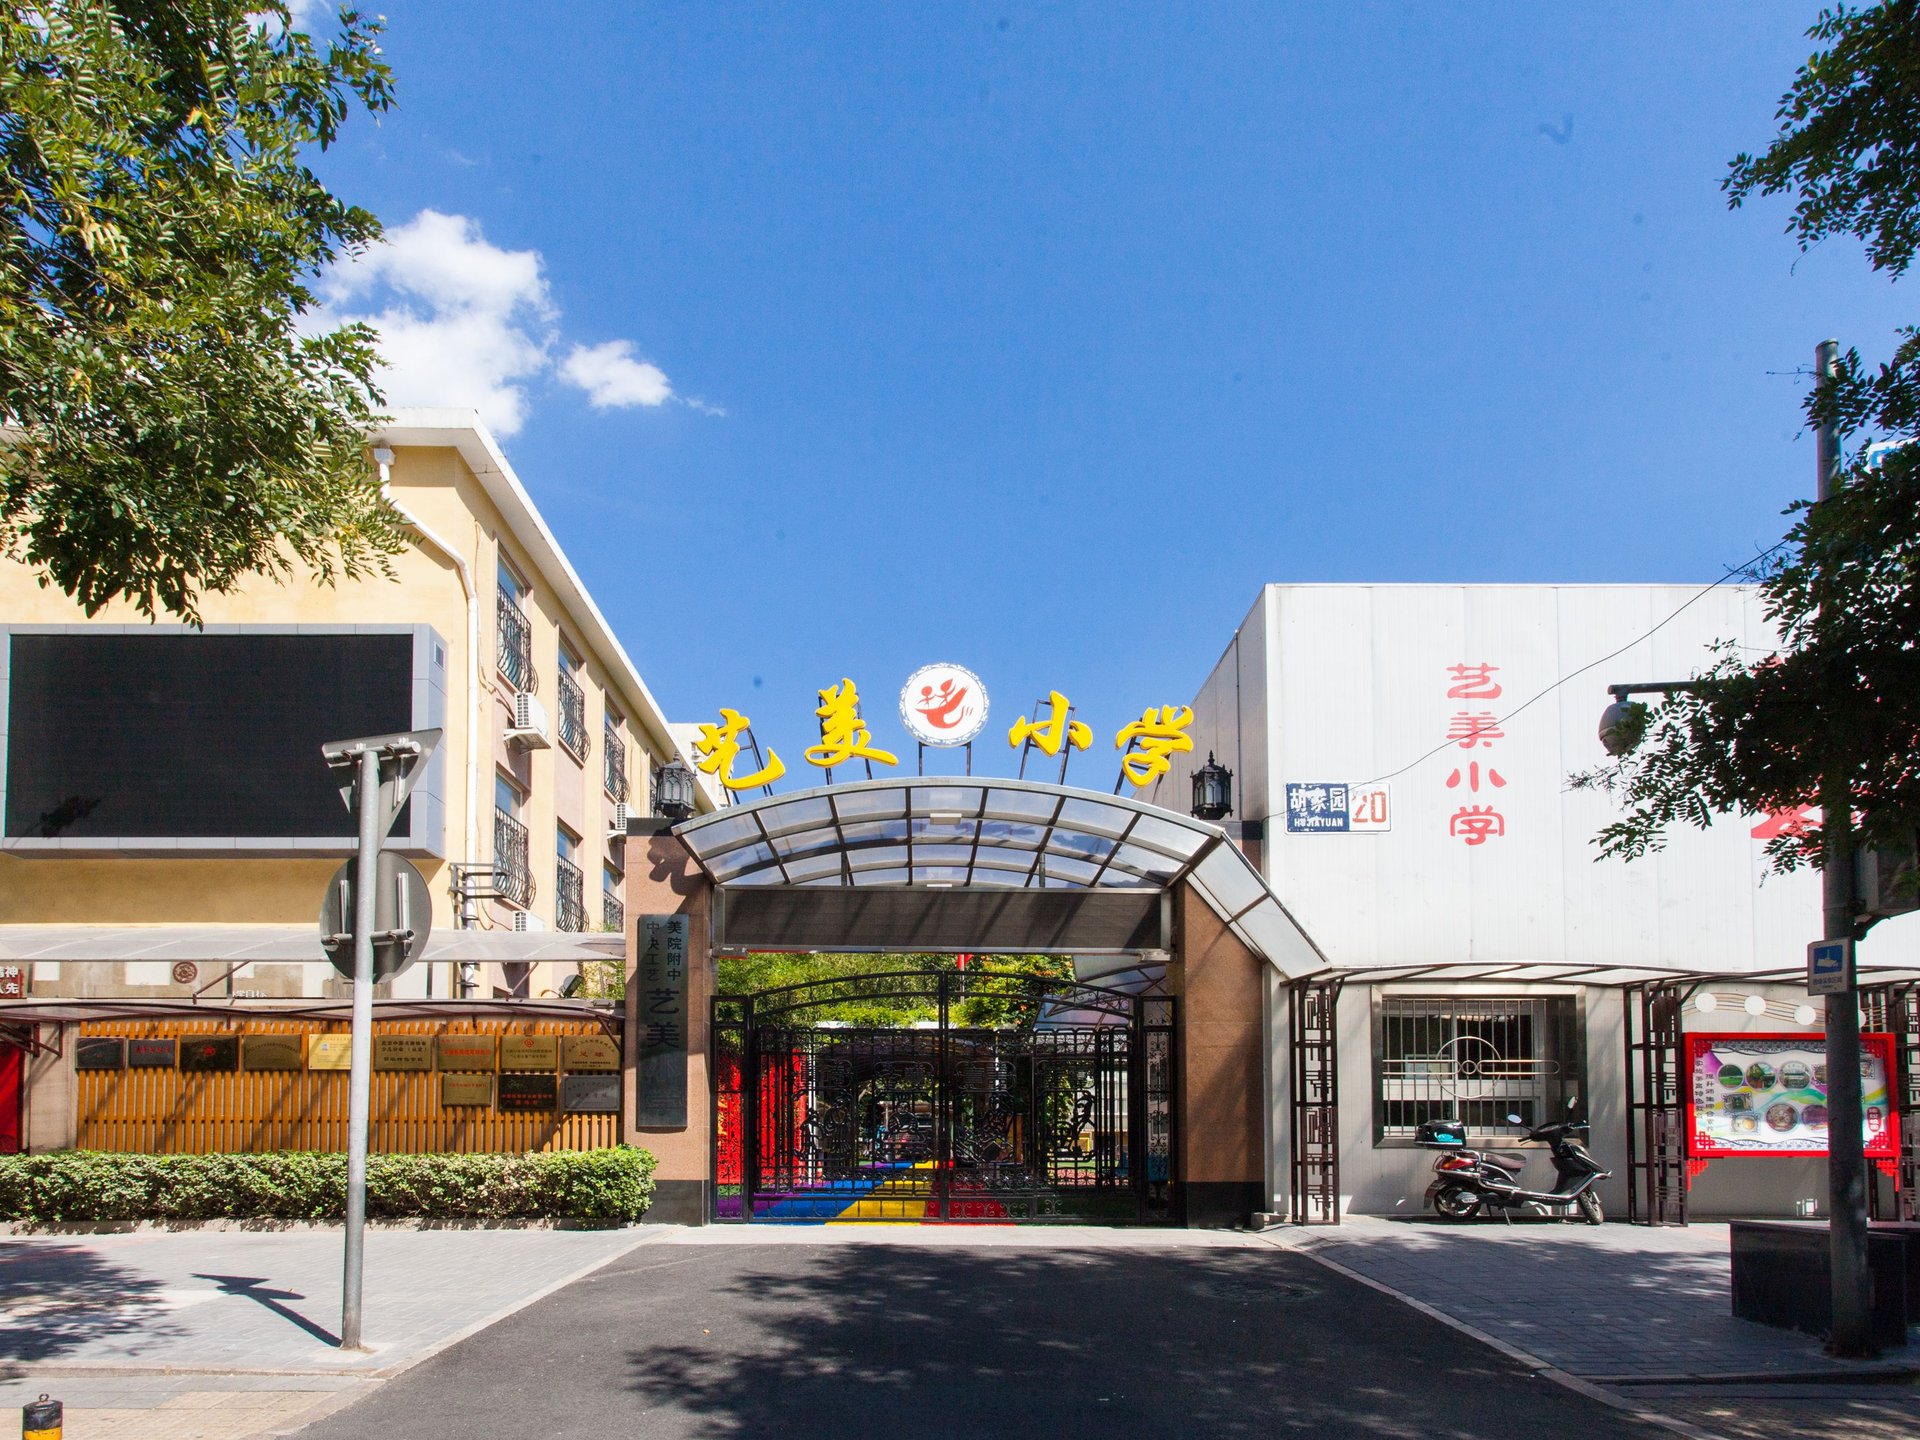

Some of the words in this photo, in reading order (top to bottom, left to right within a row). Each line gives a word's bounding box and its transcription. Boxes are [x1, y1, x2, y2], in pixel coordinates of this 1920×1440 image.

[1446, 662, 1507, 845] 艺美小学
[1289, 786, 1346, 813] 胡家园
[1294, 817, 1344, 827] HUJIAYUAN
[1351, 790, 1387, 823] 20
[646, 920, 660, 982] 中央工艺
[666, 920, 683, 982] 美院附中
